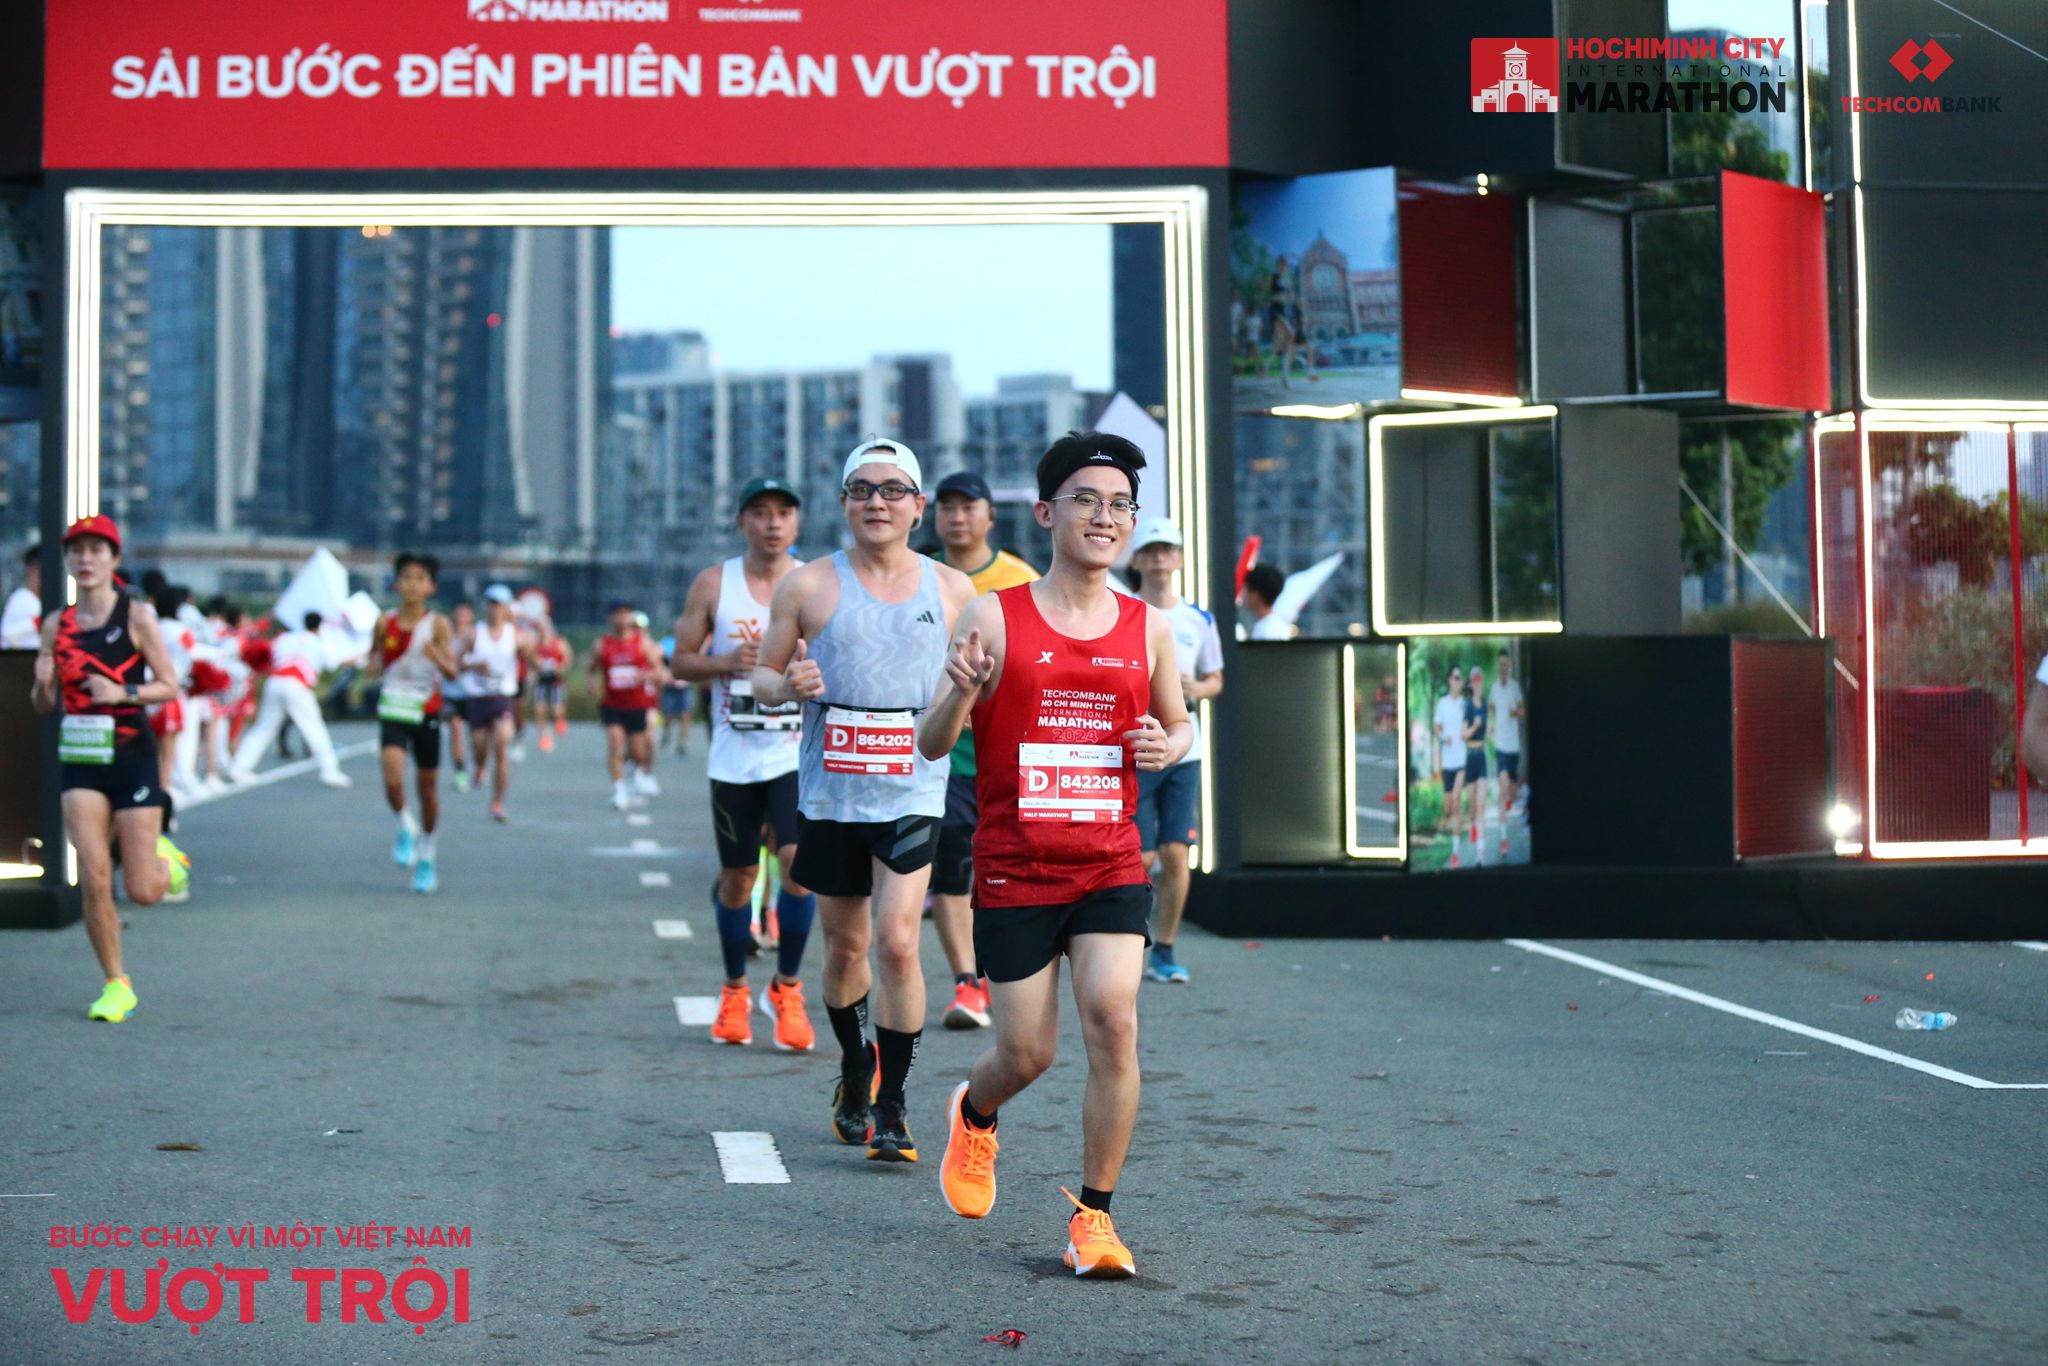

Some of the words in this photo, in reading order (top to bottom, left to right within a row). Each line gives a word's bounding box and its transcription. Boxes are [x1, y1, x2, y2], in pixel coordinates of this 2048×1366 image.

[528, 0, 668, 22] MARATHON
[111, 47, 199, 99] SẢI
[216, 42, 382, 99] BƯỚC
[394, 43, 516, 98] ĐẾN
[531, 42, 701, 98] PHIÊN
[717, 45, 838, 98] BẢN
[851, 47, 1013, 109] VƯỢT
[1025, 44, 1156, 109] TRỘI
[1042, 689, 1117, 703] TECHCOMBANK
[1054, 700, 1068, 708] CHI
[1070, 701, 1093, 709] MINH
[1095, 703, 1116, 712] CITY
[1039, 708, 1113, 720] INTERNATIONAL
[1038, 716, 1112, 730] MARATHON
[832, 728, 849, 747] D
[857, 734, 912, 746] 864202
[1052, 728, 1098, 743] 2024
[1028, 770, 1049, 792] D
[1060, 775, 1120, 789] 842208
